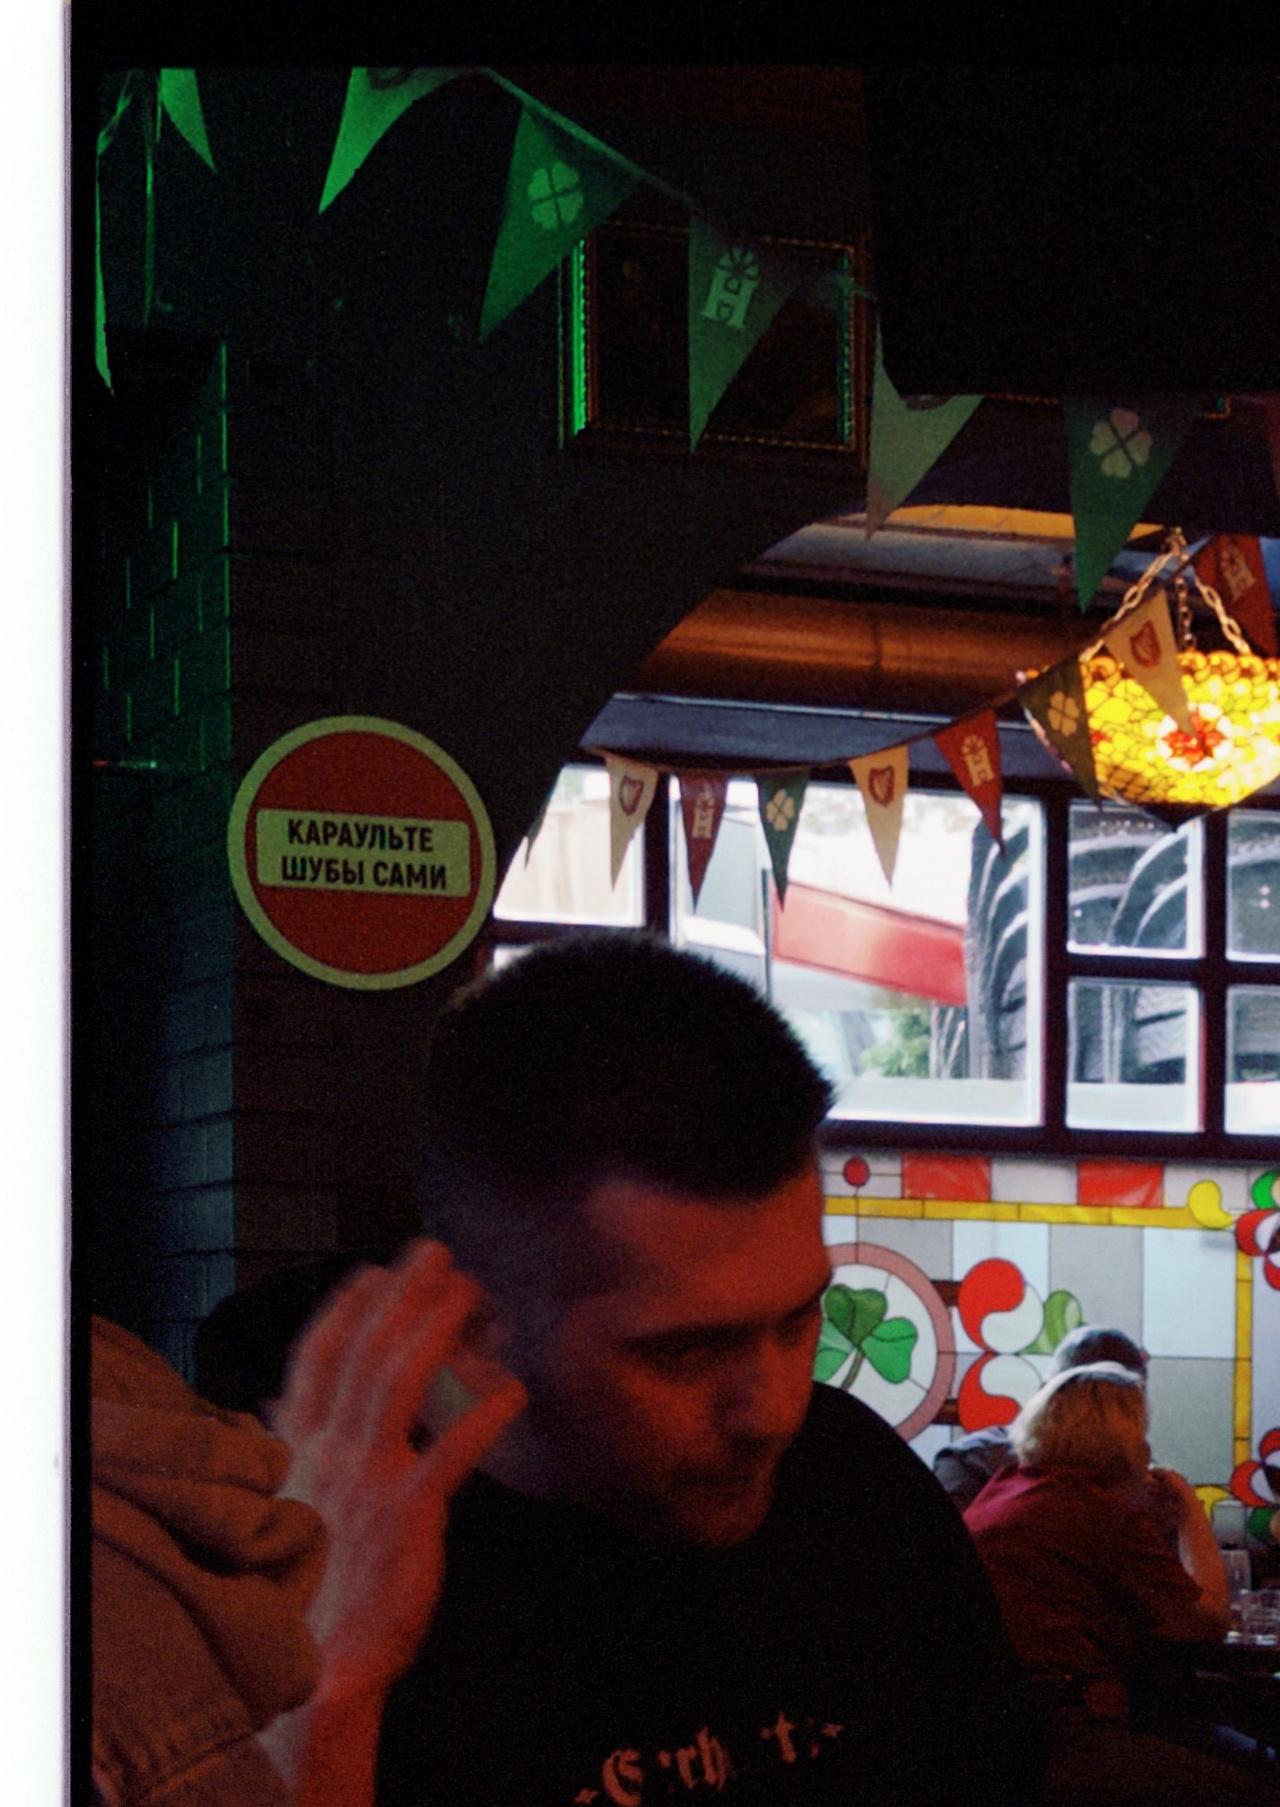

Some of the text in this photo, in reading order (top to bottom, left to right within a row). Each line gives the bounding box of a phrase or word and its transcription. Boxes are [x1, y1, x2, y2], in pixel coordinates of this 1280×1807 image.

[287, 819, 433, 852] КАРАУЛЬТЕ
[282, 856, 447, 890] ШУБЫ САМИ
